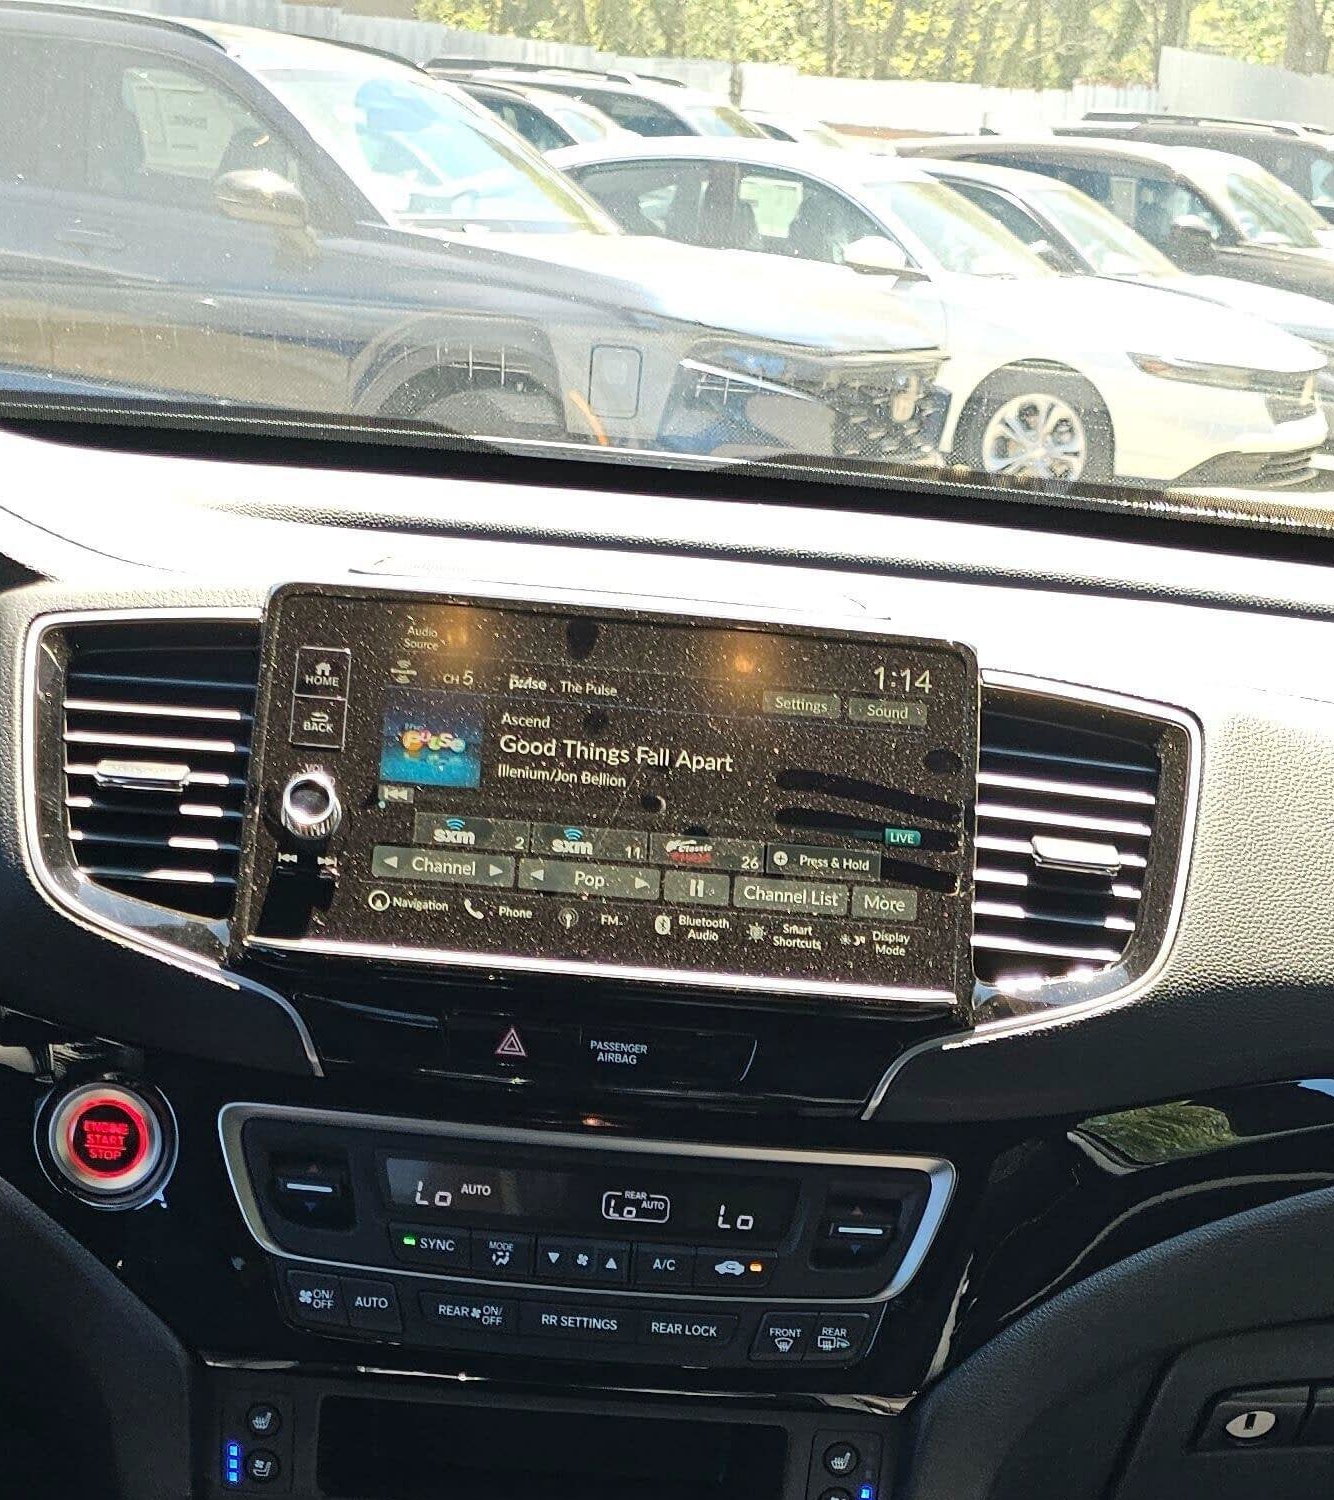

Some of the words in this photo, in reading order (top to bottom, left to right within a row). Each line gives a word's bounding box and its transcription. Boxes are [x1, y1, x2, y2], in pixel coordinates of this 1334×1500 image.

[407, 625, 438, 638] Audio
[403, 637, 439, 650] Source
[305, 674, 340, 688] HOME
[443, 673, 459, 685] CH
[462, 670, 474, 686] 5
[873, 666, 933, 694] 1:14
[560, 680, 583, 695] The
[585, 683, 618, 697] Pulse
[775, 698, 828, 714] Settings
[867, 705, 909, 720] Sound
[303, 720, 335, 734] BACK
[501, 712, 551, 729] Ascend
[499, 734, 556, 757] Good
[562, 739, 630, 766] Things
[636, 746, 669, 767] Fall
[675, 750, 734, 773] Apart
[498, 764, 578, 784] Illenium/Jon
[581, 772, 627, 789] Bellion
[514, 837, 525, 850] 2
[890, 832, 915, 845] LIVE
[625, 846, 641, 860] 11
[412, 856, 476, 877] Channel
[741, 855, 759, 870] 26
[799, 854, 829, 869] Press
[831, 858, 840, 869] &
[843, 858, 870, 872] Hold
[574, 870, 605, 890] Pop
[744, 885, 807, 905] Channel
[811, 889, 838, 907] List
[864, 894, 906, 912] More
[392, 896, 449, 912] Navigation
[498, 905, 533, 919] Phone
[600, 914, 619, 926] FM
[678, 914, 730, 929] Bluetooth
[687, 928, 719, 941] Audio
[782, 924, 813, 937] Smart
[872, 930, 910, 945] Display
[773, 935, 822, 951] Shortcuts
[875, 944, 906, 956] Mode
[590, 1040, 648, 1054] PASSENGER
[597, 1051, 637, 1065] AIRBAG
[87, 1134, 125, 1146] START
[89, 1149, 122, 1160] STOP
[461, 1184, 491, 1196] AUTO
[624, 1191, 647, 1200] REAR
[641, 1200, 665, 1210] AUTO
[420, 1238, 455, 1251] SYNC
[489, 1241, 514, 1251] MODE
[652, 1258, 676, 1271] A/C
[313, 1288, 334, 1300] ON/
[313, 1299, 334, 1309] OFF
[354, 1296, 389, 1309] AUTO
[438, 1304, 470, 1317] REAR
[482, 1305, 503, 1316] ON/
[482, 1315, 502, 1326] OFF
[541, 1314, 559, 1326] RR
[560, 1316, 618, 1331] SETTINGS
[651, 1322, 682, 1335] REAR
[685, 1324, 718, 1337] LOCK
[769, 1327, 802, 1338] FRONT
[822, 1327, 847, 1337] REAR
